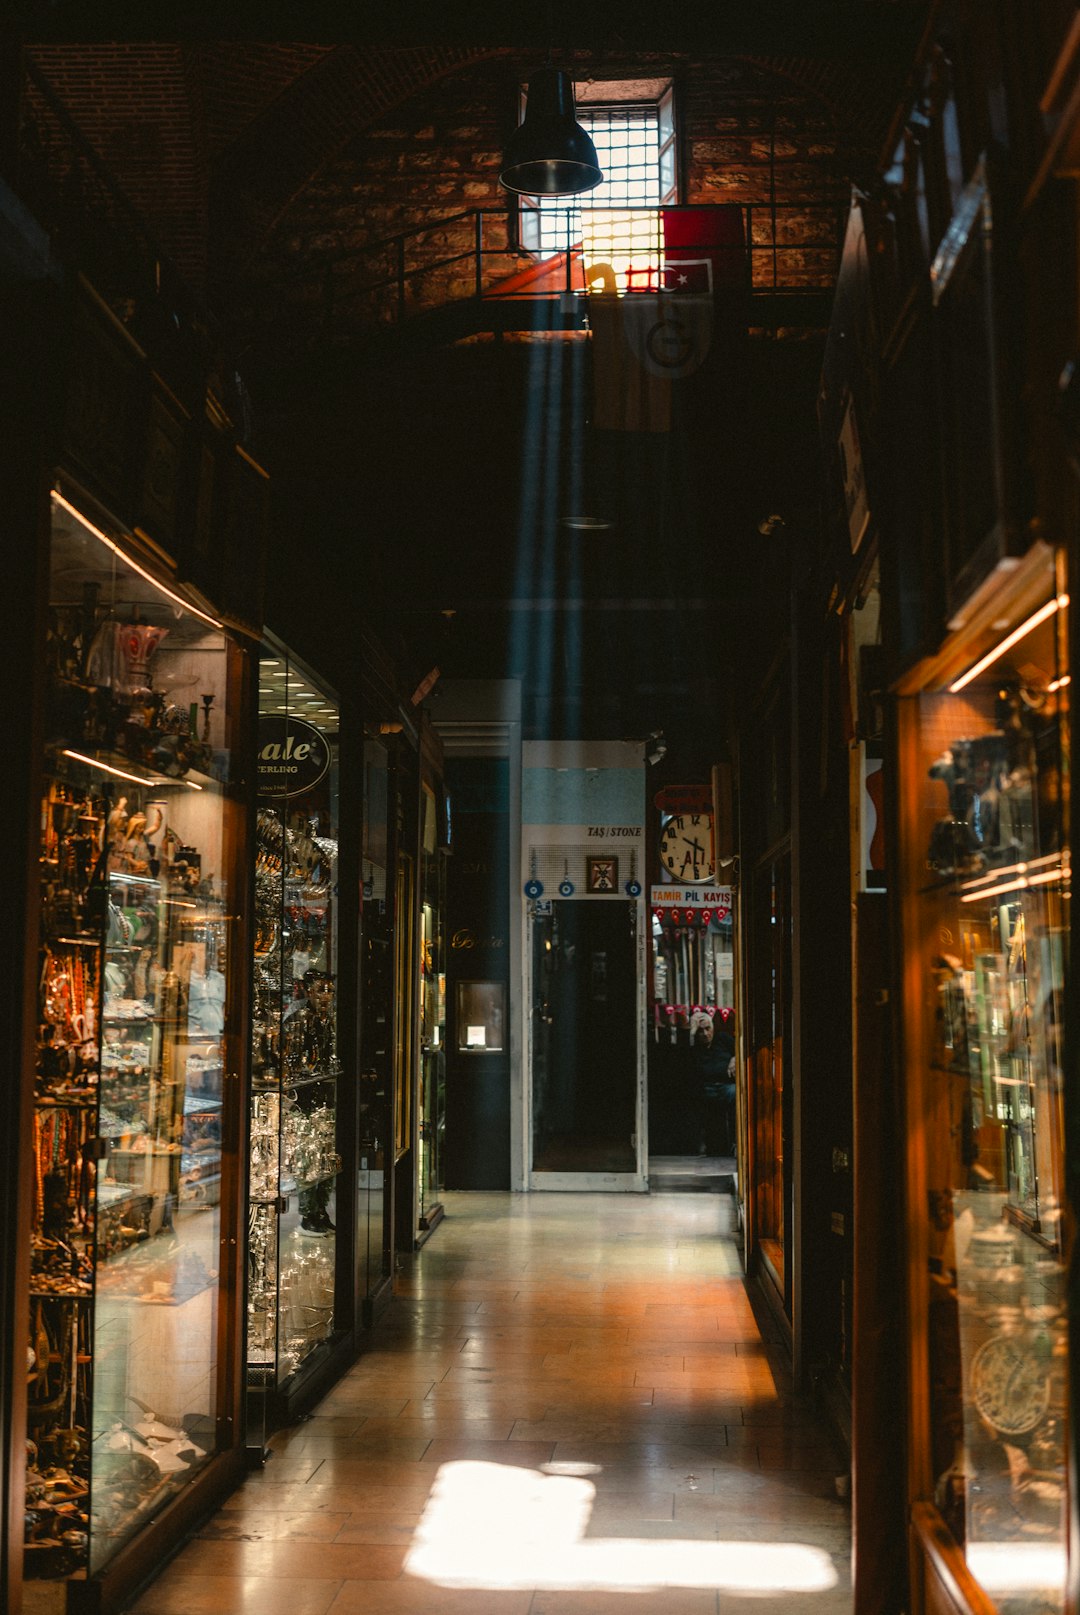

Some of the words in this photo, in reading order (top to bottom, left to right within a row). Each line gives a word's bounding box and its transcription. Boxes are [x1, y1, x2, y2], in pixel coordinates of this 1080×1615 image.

[257, 736, 311, 761] ale
[587, 827, 605, 838] TAŞ
[610, 827, 642, 837] STONE
[652, 889, 682, 901] TAMİR
[685, 890, 700, 902] PİL
[703, 892, 731, 905] KAYIŞ
